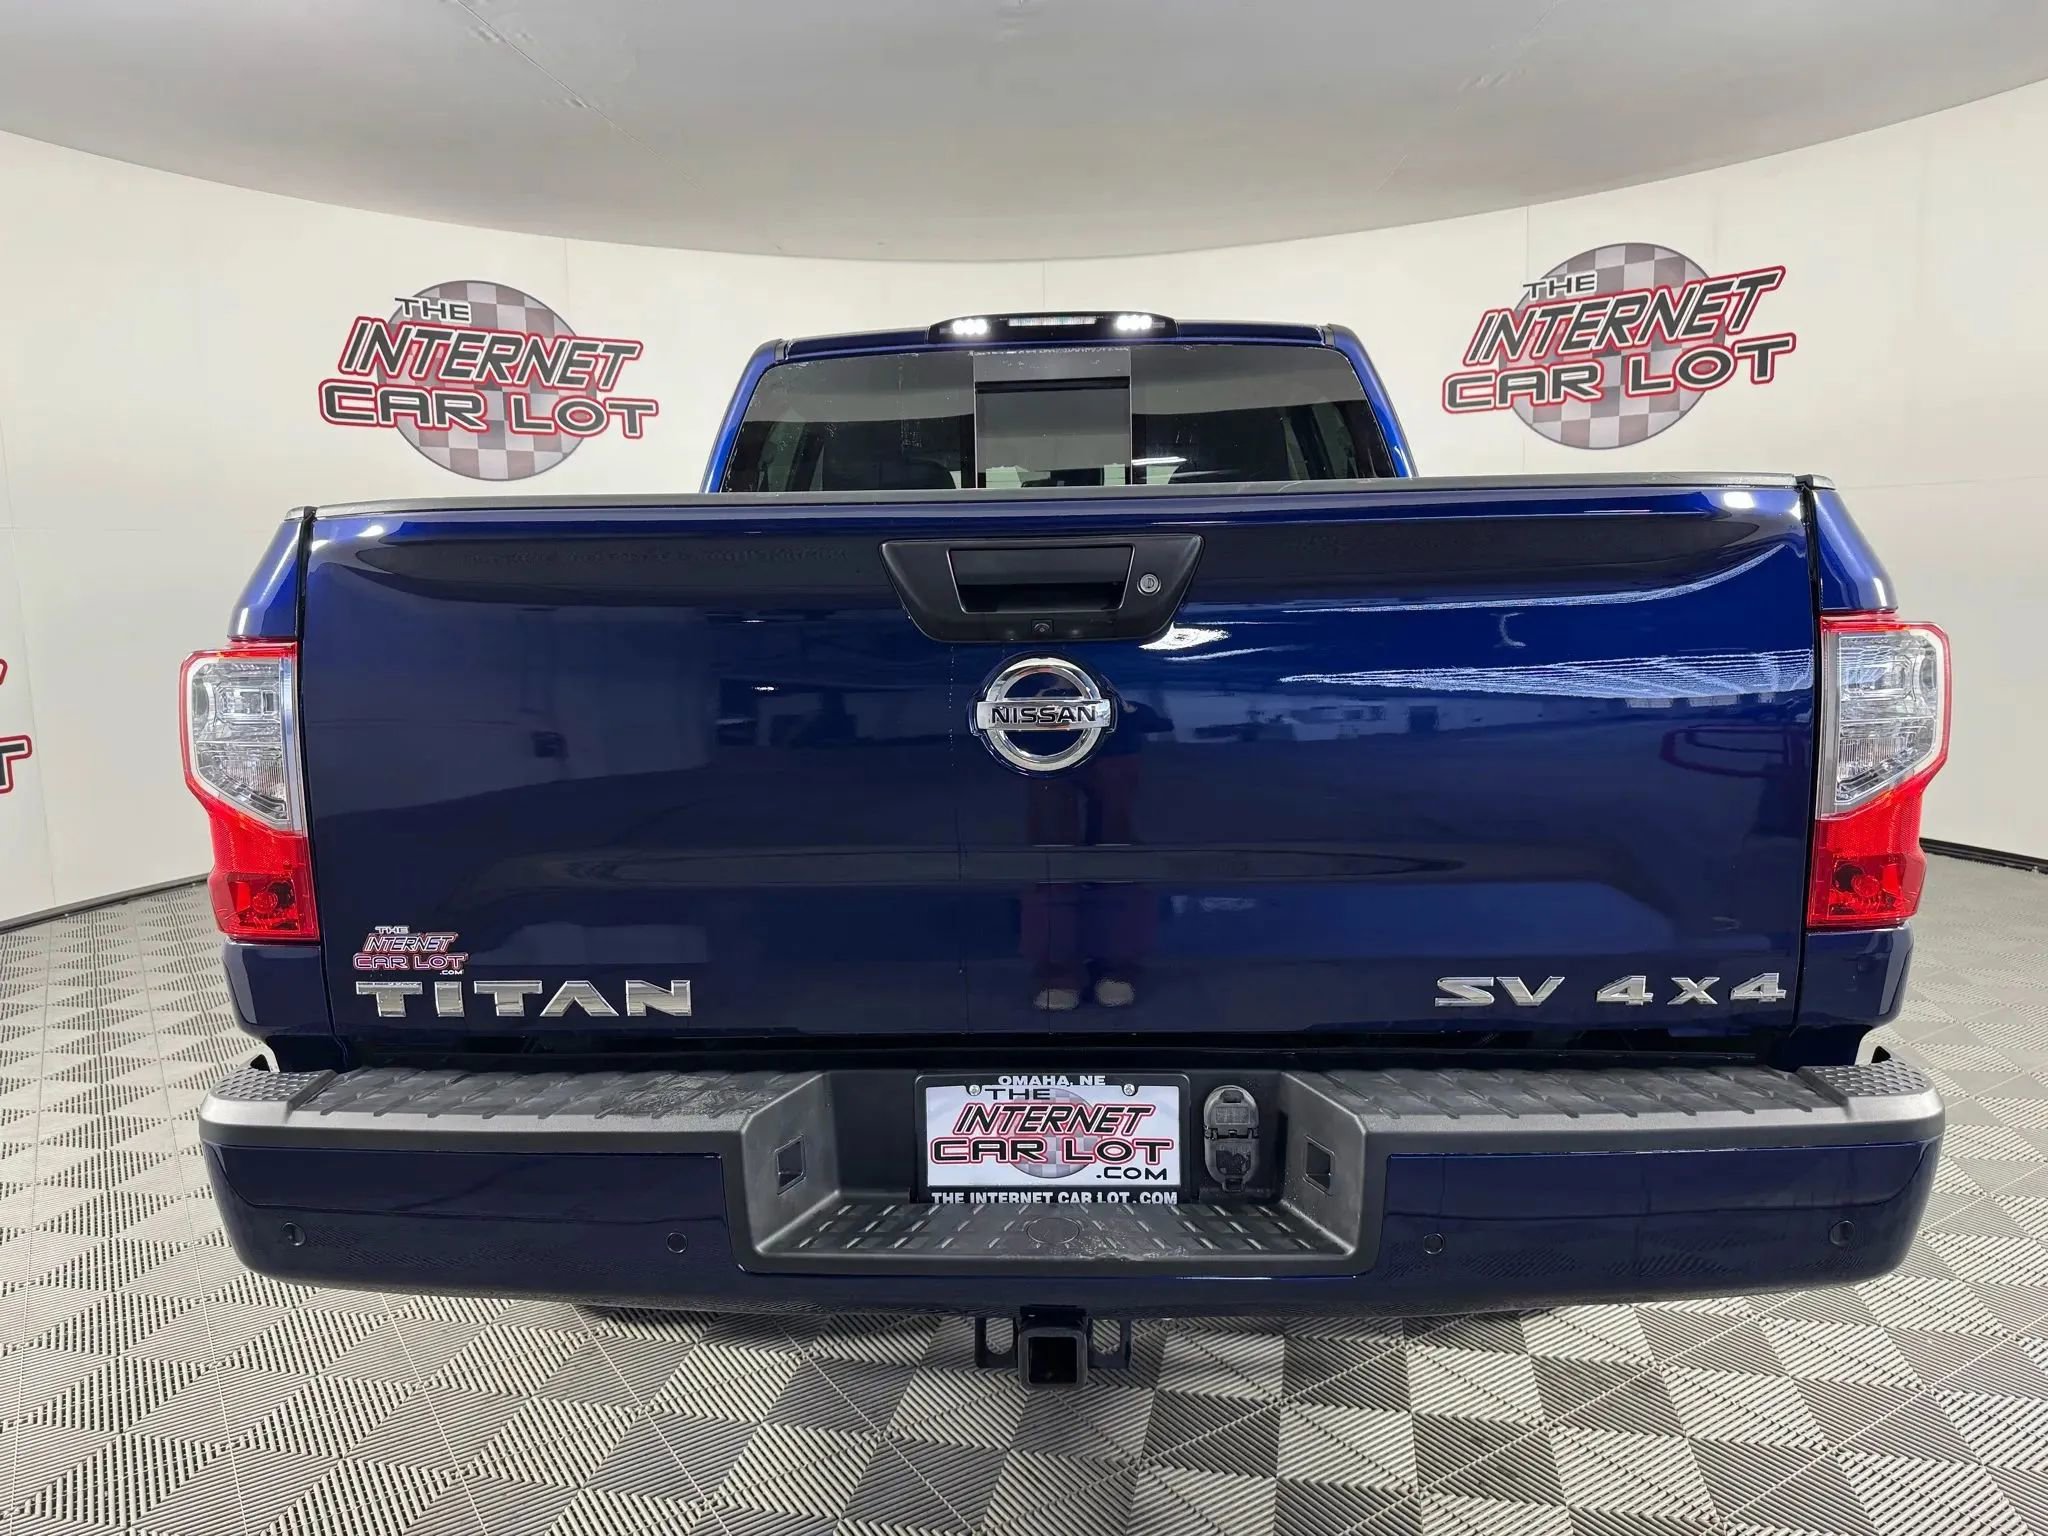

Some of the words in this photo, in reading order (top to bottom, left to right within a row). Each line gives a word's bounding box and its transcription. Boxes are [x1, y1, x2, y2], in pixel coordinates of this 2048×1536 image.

[1523, 273, 1597, 298] THE
[395, 297, 472, 322] THE
[1465, 266, 1784, 364] INTERNET
[340, 317, 641, 391] INTERNET
[1444, 361, 1603, 411] CAR
[1628, 335, 1794, 394] LOT
[320, 380, 487, 431] CAR
[510, 394, 656, 437] LOT
[991, 706, 1096, 723] NISSAN
[375, 926, 409, 934] THE
[363, 933, 458, 953] INTERNET
[353, 953, 408, 970] CAR
[413, 953, 468, 970] LOT
[356, 980, 691, 1017] TITAN
[1435, 976, 1565, 1006] SV
[1079, 1075, 1106, 1086] NE
[985, 1088, 1050, 1100] THE
[954, 1103, 1154, 1135] INTERNET
[932, 1139, 1046, 1163] CAR
[1064, 1139, 1173, 1164] LOT
[1096, 1166, 1168, 1181] .COM
[931, 1192, 964, 1203] THE
[970, 1192, 1053, 1203] INTERNET
[1057, 1192, 1092, 1204] CAR
